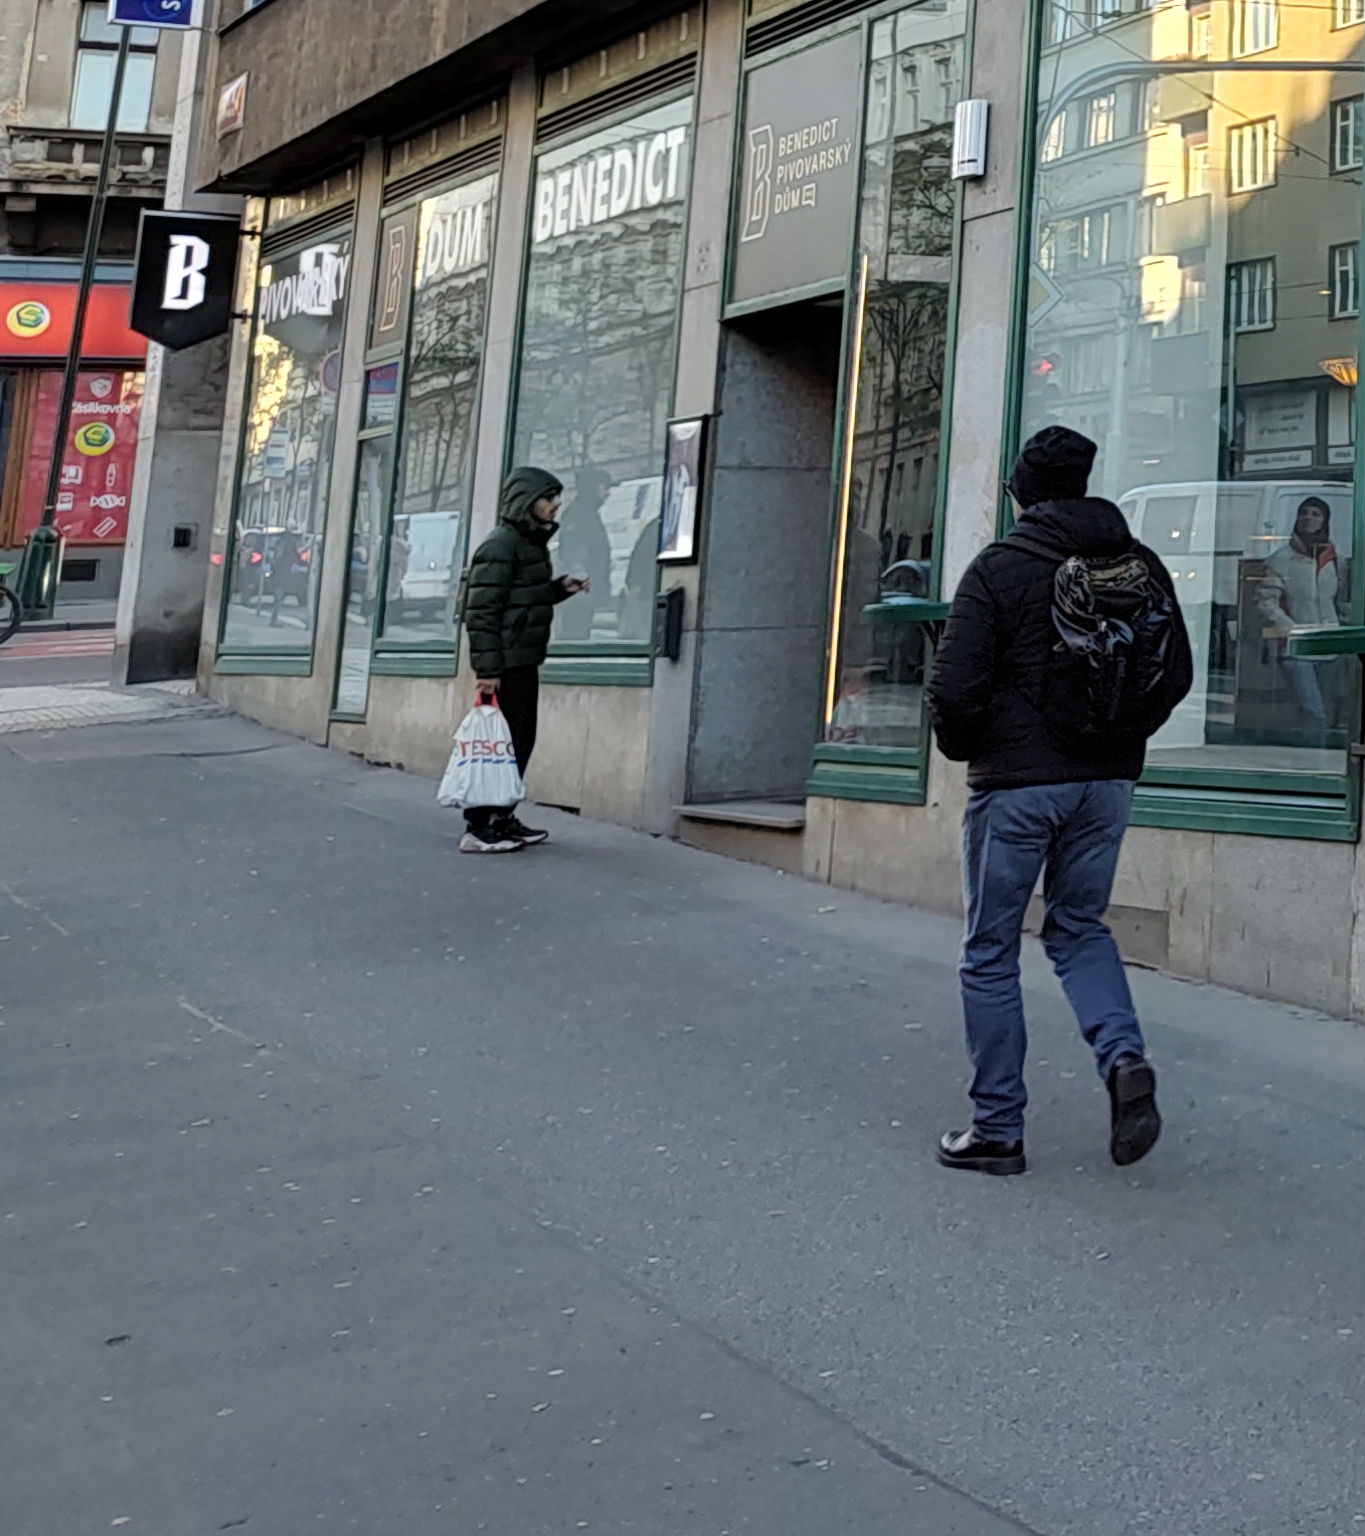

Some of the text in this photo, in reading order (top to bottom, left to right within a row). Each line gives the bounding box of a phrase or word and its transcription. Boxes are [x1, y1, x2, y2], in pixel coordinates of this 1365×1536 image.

[778, 118, 839, 157] BENEDICT
[776, 137, 852, 186] PIVOVARSKÝ
[535, 125, 687, 244] BENEDICT
[774, 186, 800, 214] DŮM
[161, 234, 210, 311] B
[460, 740, 516, 757] TESCO
